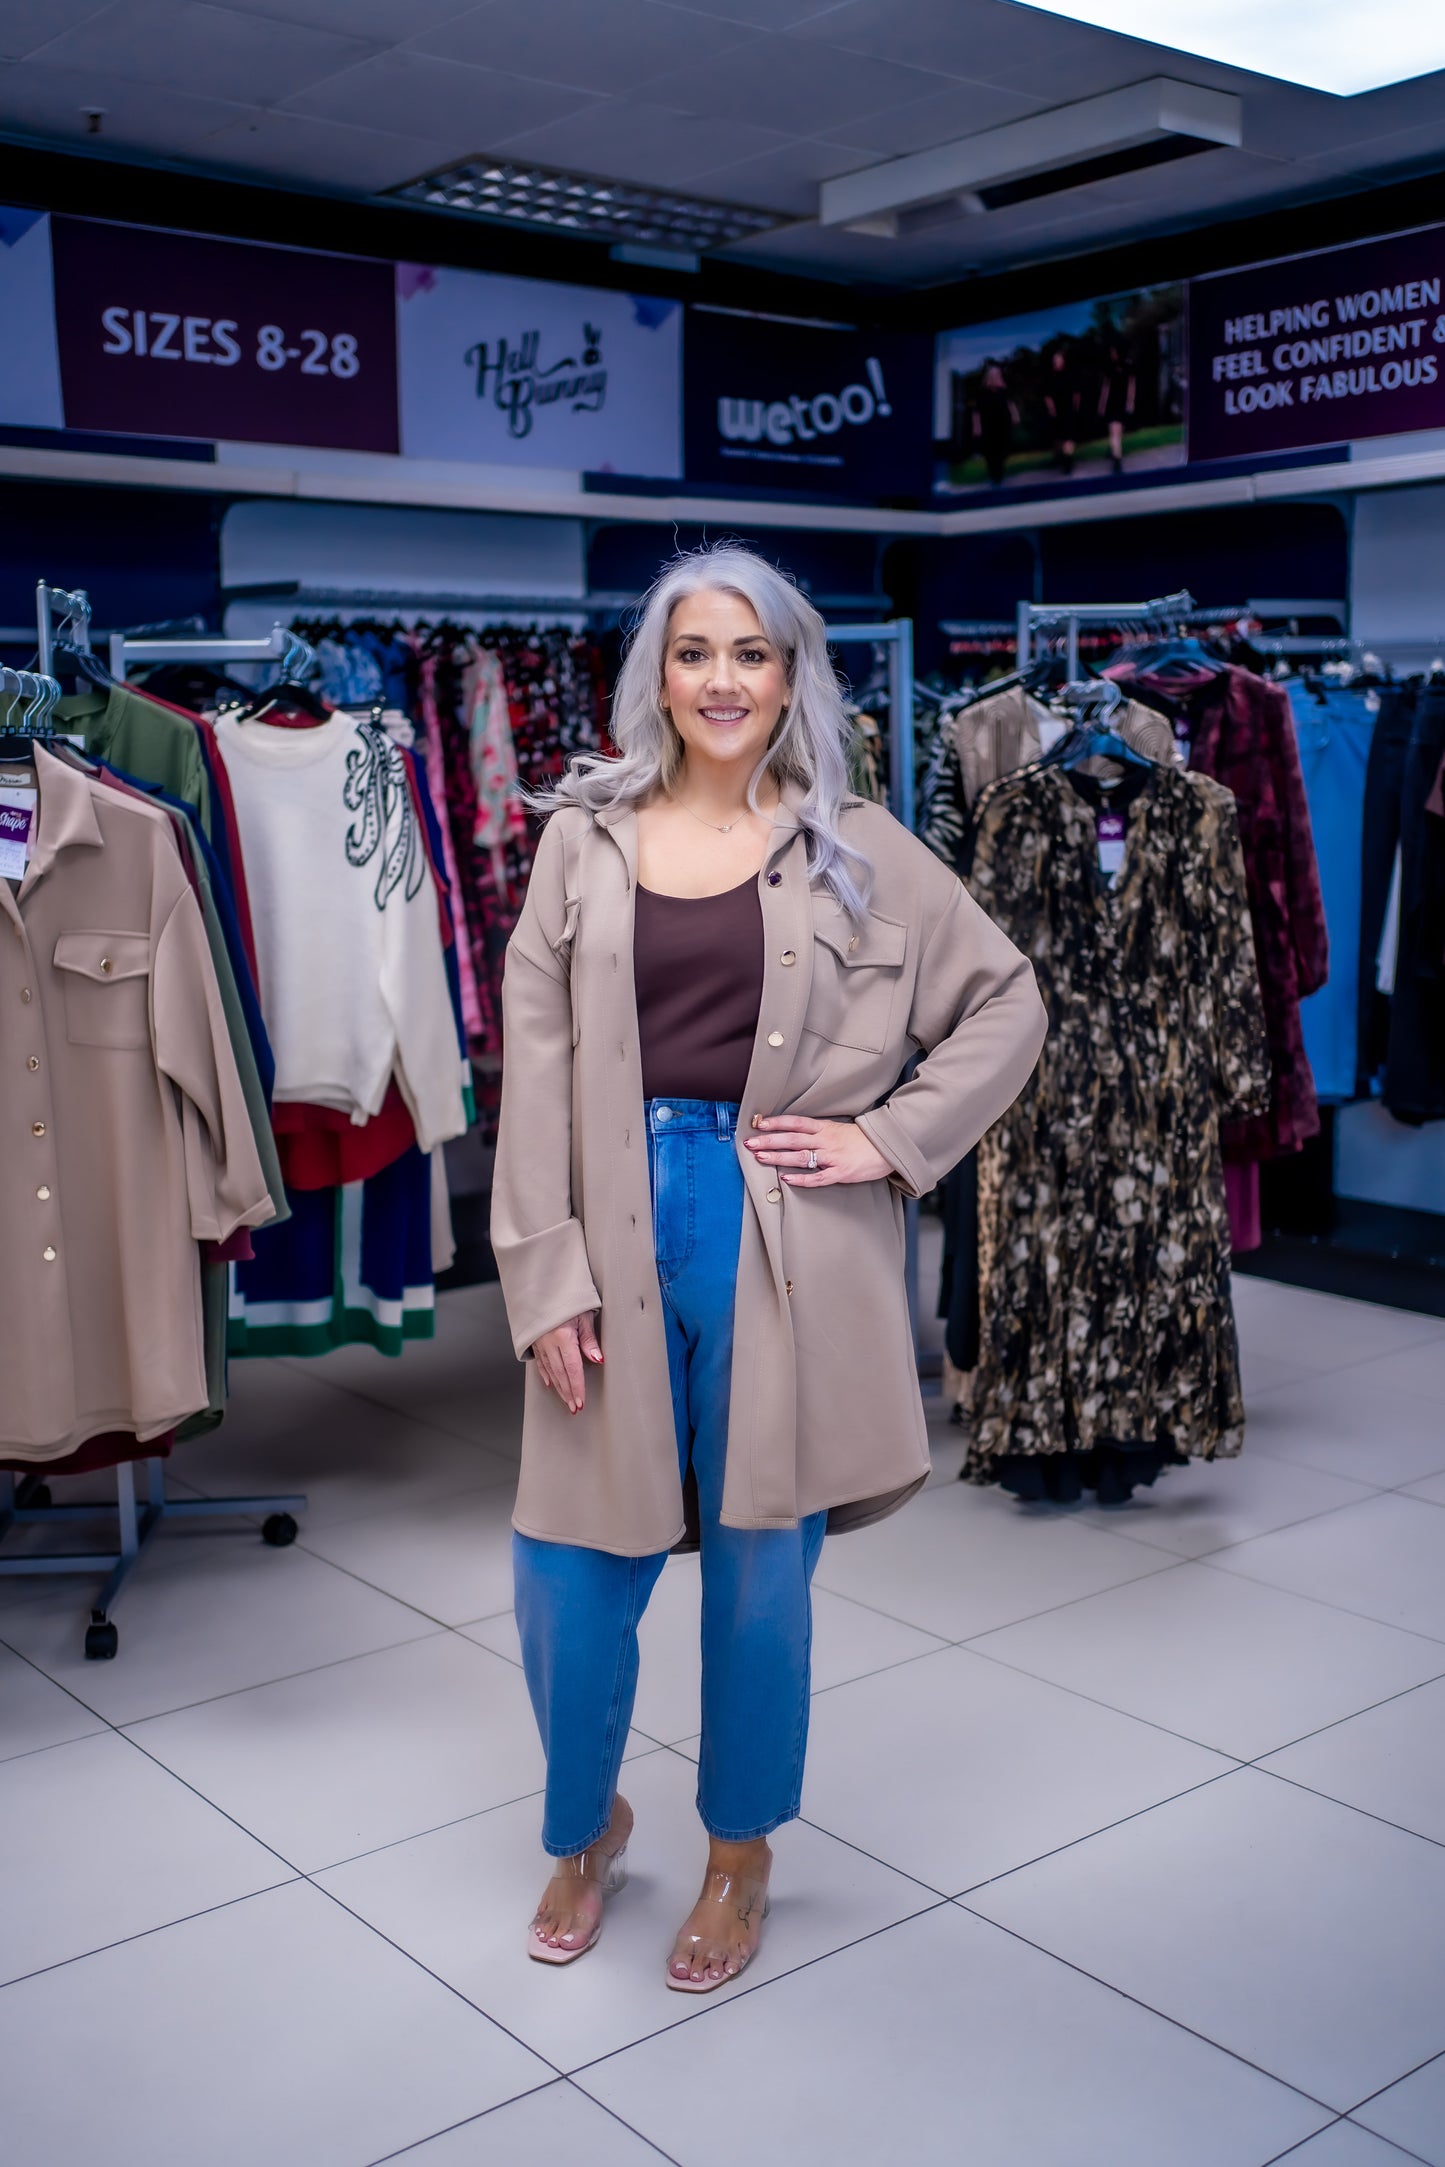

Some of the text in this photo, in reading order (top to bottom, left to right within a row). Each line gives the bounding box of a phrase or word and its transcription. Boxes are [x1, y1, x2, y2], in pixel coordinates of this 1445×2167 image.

[101, 306, 360, 379] SIZES 8-28
[1224, 277, 1441, 345] HELPING WOMEN
[464, 329, 577, 399] Hell
[1212, 350, 1269, 382] FEEL
[1272, 318, 1428, 371] CONFIDENT
[1224, 354, 1438, 415] LOOK FABULOUS
[717, 356, 892, 445] wetoo!
